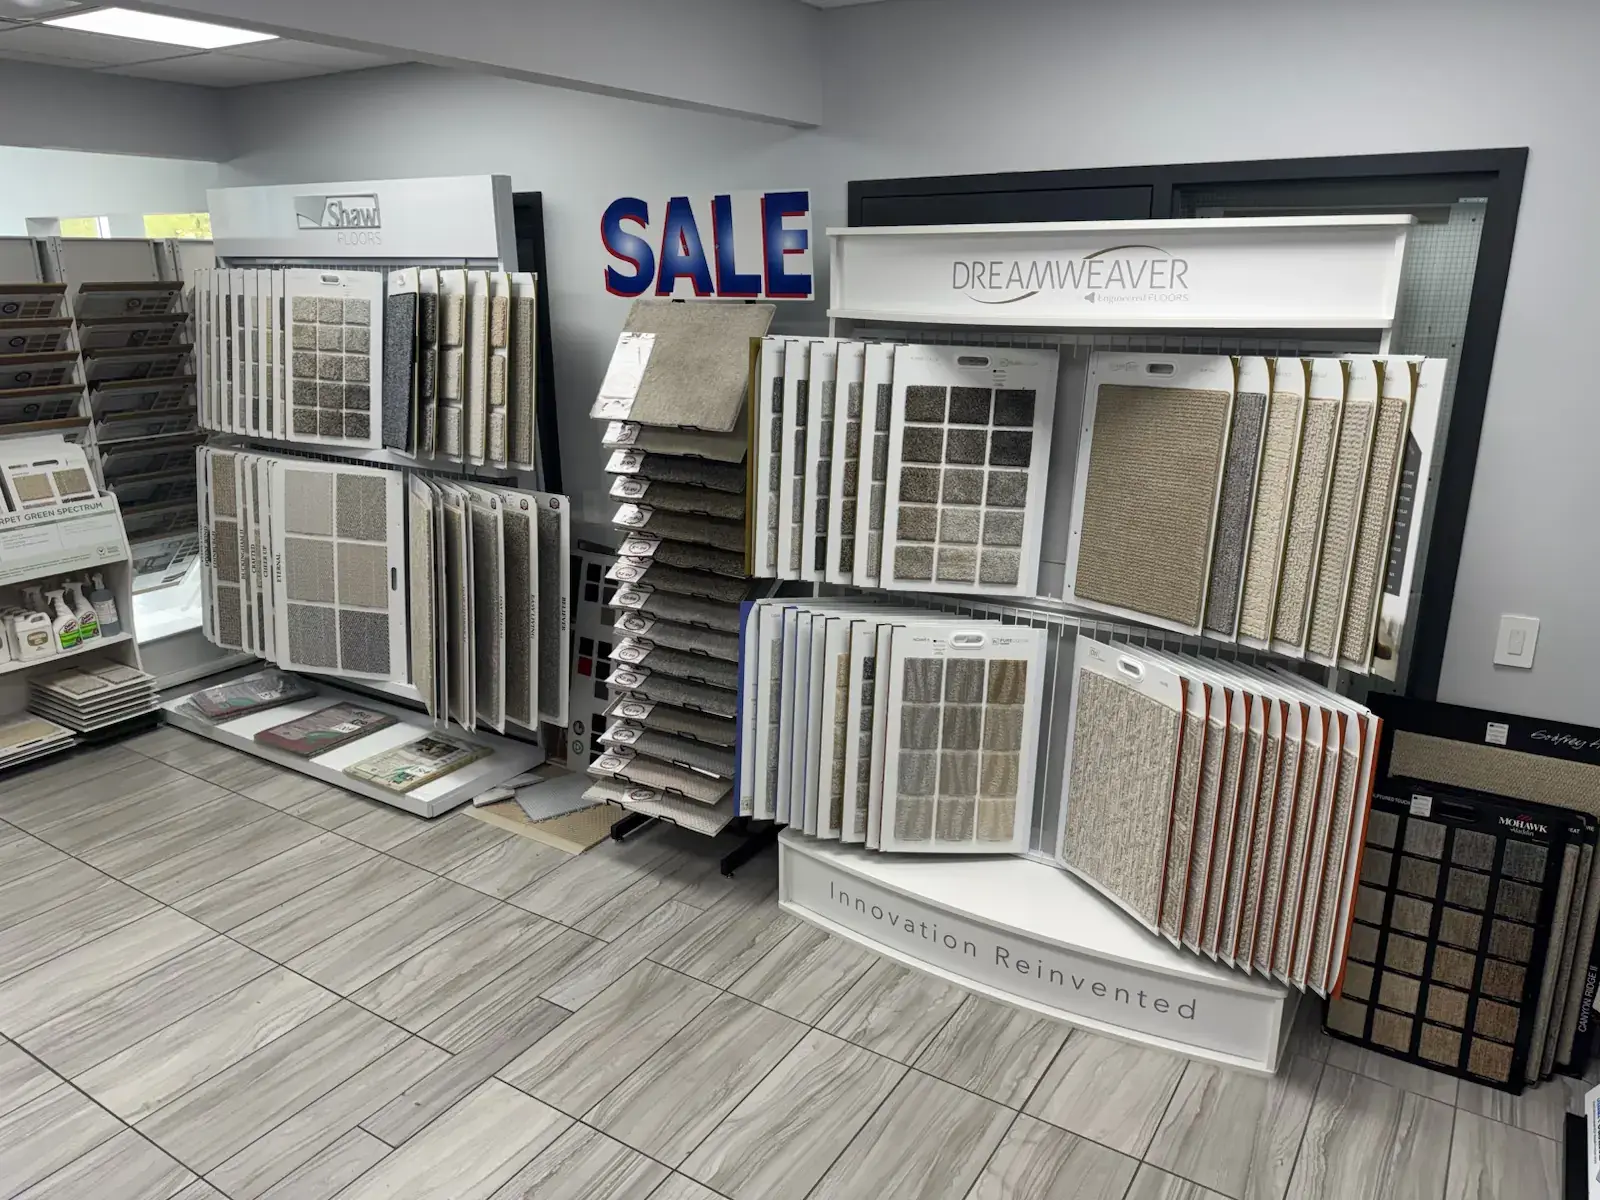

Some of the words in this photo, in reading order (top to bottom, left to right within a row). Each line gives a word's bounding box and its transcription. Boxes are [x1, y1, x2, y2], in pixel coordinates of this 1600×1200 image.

[327, 200, 378, 227] Shaw
[337, 231, 382, 246] FLOORS
[600, 191, 812, 298] SALE
[952, 259, 1189, 290] DREAMWEAVER
[1098, 293, 1146, 304] Engineered
[1147, 293, 1189, 302] FLOORS
[24, 509, 55, 521] GREEN
[57, 502, 103, 516] SPECTRUM
[1530, 729, 1587, 750] Godfrey
[1498, 816, 1548, 834] MOHAWK
[829, 881, 977, 958] Innovation
[995, 945, 1197, 1020] Reinvented
[1578, 999, 1592, 1033] CANYON
[1585, 972, 1597, 998] RIDGE
